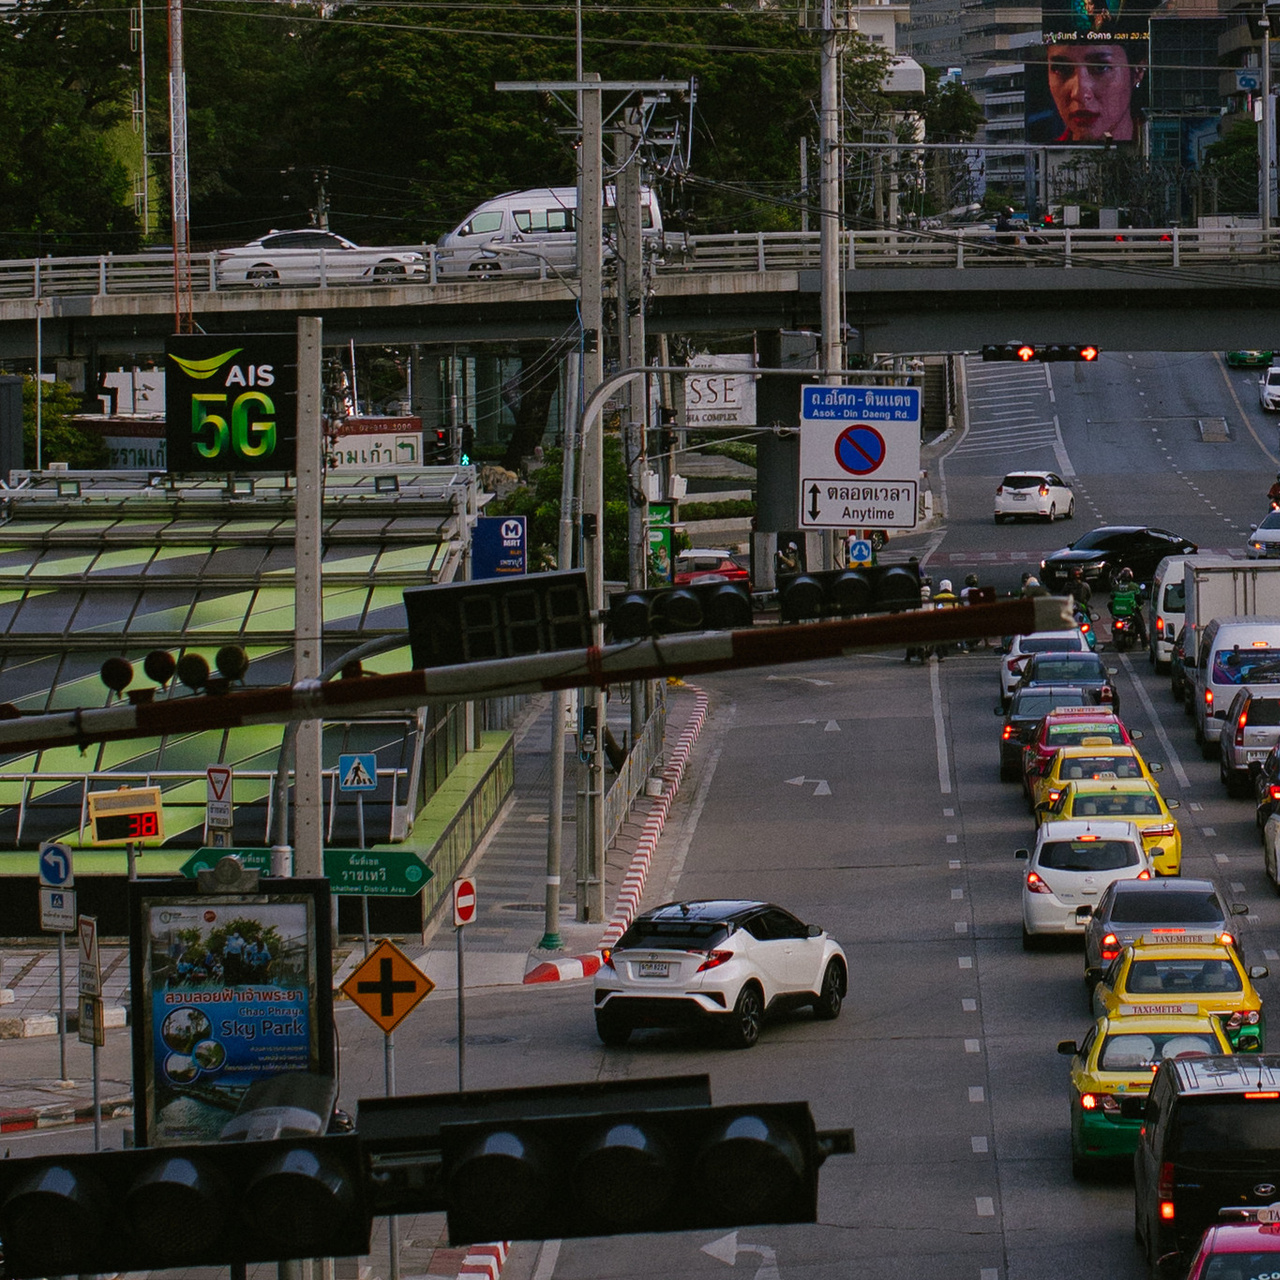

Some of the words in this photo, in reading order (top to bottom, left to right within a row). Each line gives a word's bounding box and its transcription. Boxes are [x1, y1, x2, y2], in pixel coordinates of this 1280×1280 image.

[224, 364, 276, 387] AIS
[702, 413, 738, 422] COMPLEX
[812, 409, 836, 418] Asok
[843, 409, 858, 418] Din
[862, 409, 891, 420] Daeng
[894, 410, 910, 419] Rd.
[191, 391, 277, 459] 5G
[827, 487, 910, 502] ตลอดเวลา
[842, 506, 895, 522] Anytime
[502, 539, 522, 547] MRT
[128, 812, 157, 838] 38
[341, 867, 387, 882] ราชเทวี
[164, 988, 305, 1004] สวนลอยฟ้าเจ้าพระยา
[238, 1006, 266, 1017] Chao
[267, 1006, 305, 1018] Phraya
[220, 1020, 255, 1039] Sky
[261, 1019, 305, 1036] Park
